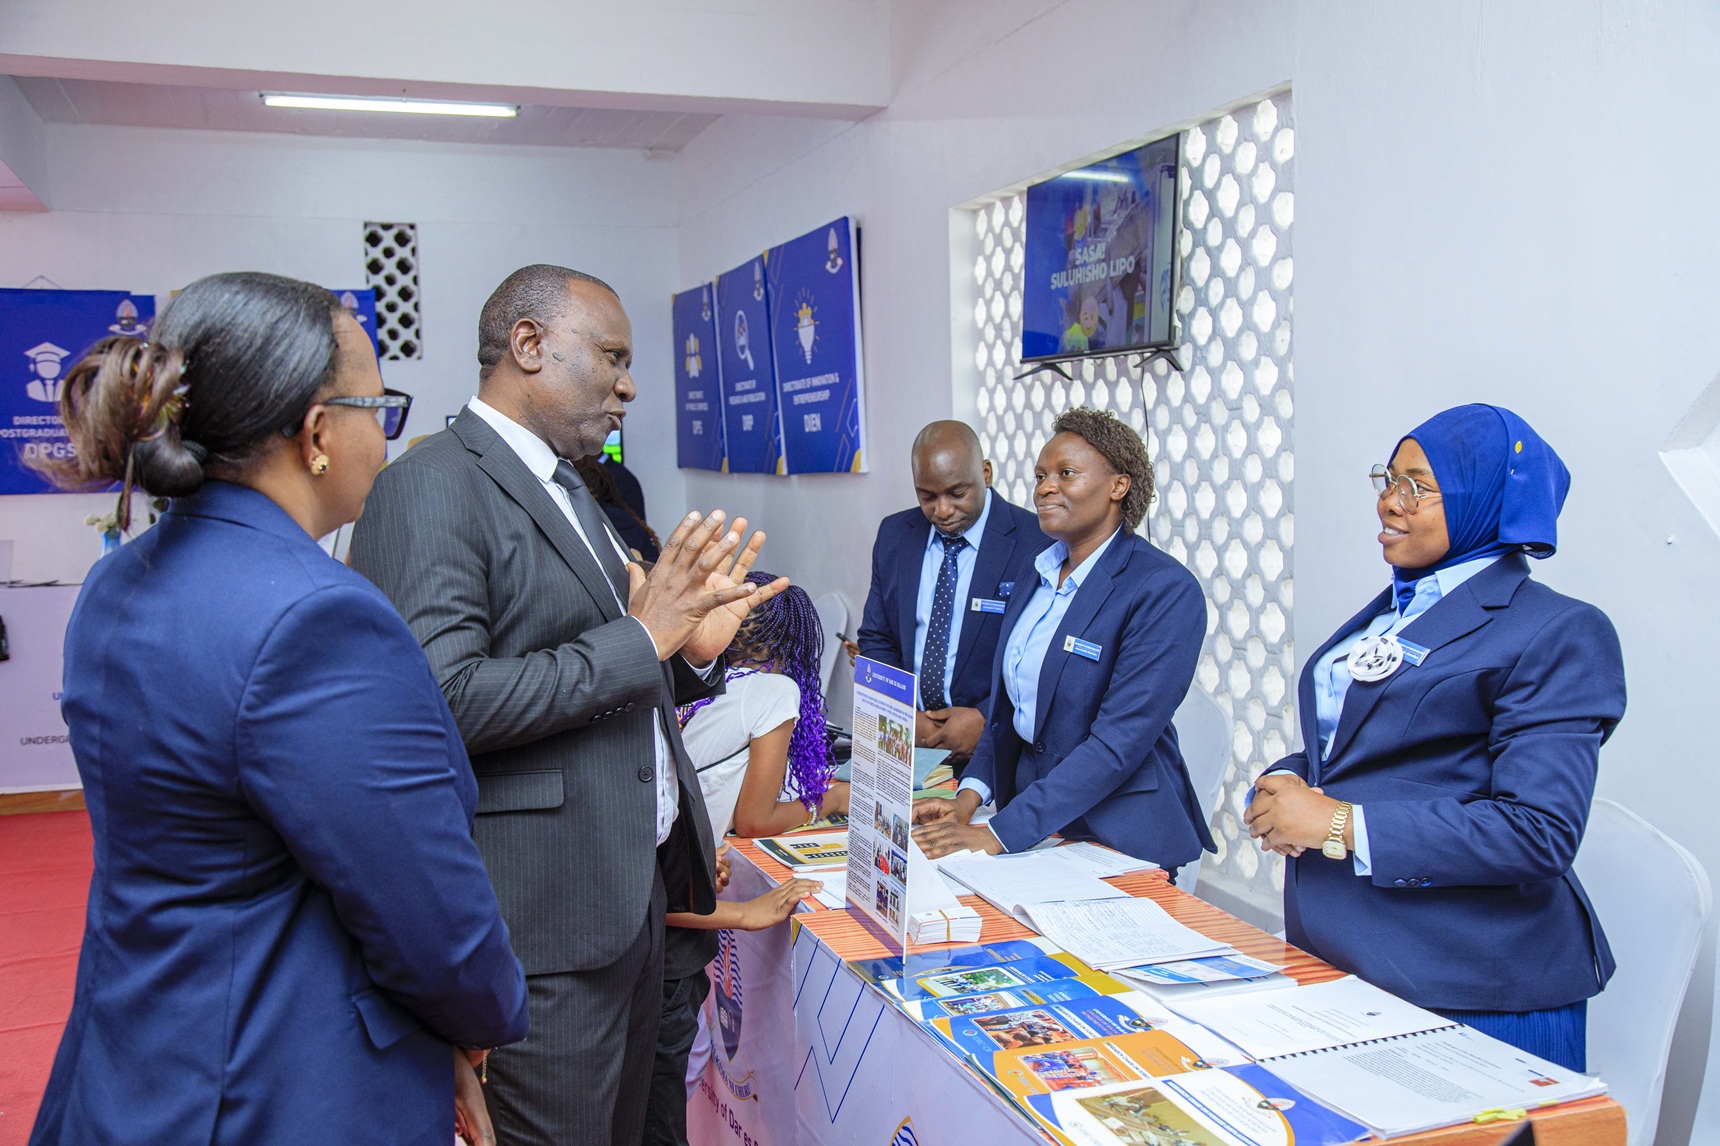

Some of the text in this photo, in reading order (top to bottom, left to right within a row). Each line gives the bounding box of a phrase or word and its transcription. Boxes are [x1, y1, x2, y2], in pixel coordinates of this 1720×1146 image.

[1076, 242, 1106, 264] SASA!
[1051, 256, 1135, 290] SULUHISHO LIPO
[24, 442, 77, 458] DPGS
[20, 735, 69, 746] UNDERG
[700, 1079, 719, 1113] ersity
[721, 1103, 727, 1121] of
[729, 1108, 742, 1138] Dar
